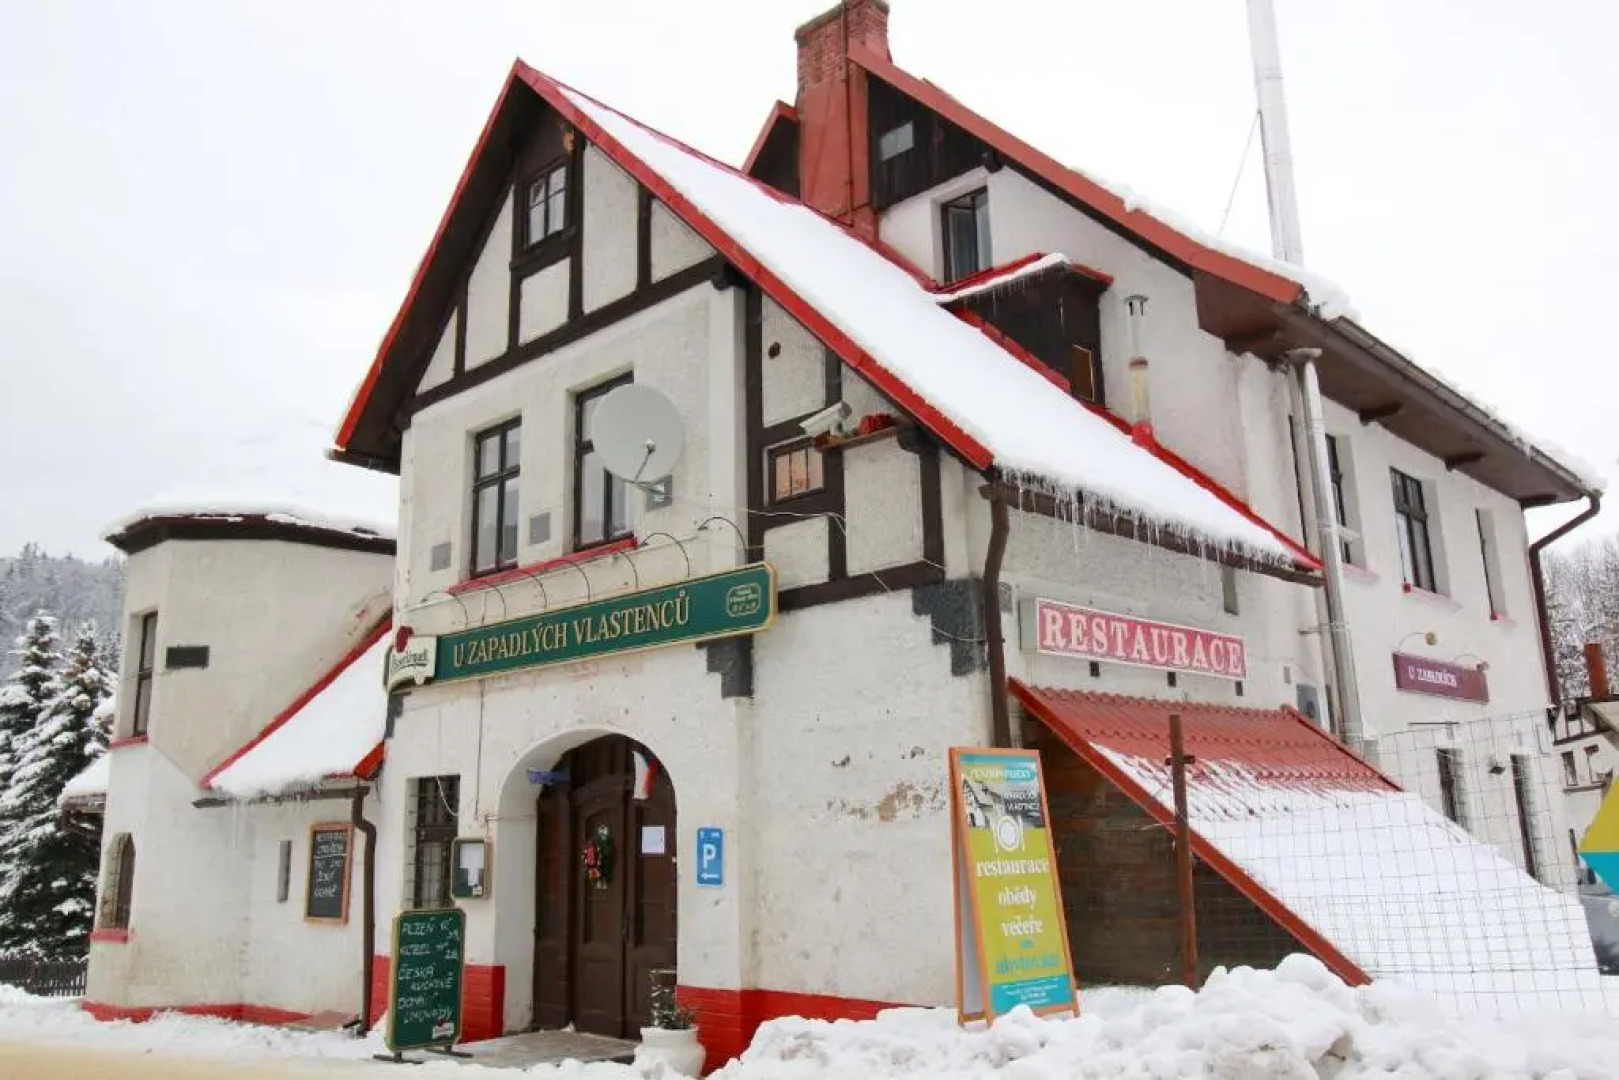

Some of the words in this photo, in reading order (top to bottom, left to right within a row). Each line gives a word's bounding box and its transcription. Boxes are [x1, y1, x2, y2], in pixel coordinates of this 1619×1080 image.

[453, 645, 462, 667] U
[467, 623, 567, 665] ZAPADLÝCH
[574, 589, 691, 645] VLASTENCŮ
[1042, 608, 1243, 673] RESTAURACE
[703, 844, 716, 869] P
[977, 859, 1050, 877] restaurace
[998, 885, 1036, 910] obědy
[1001, 914, 1044, 937] večeře
